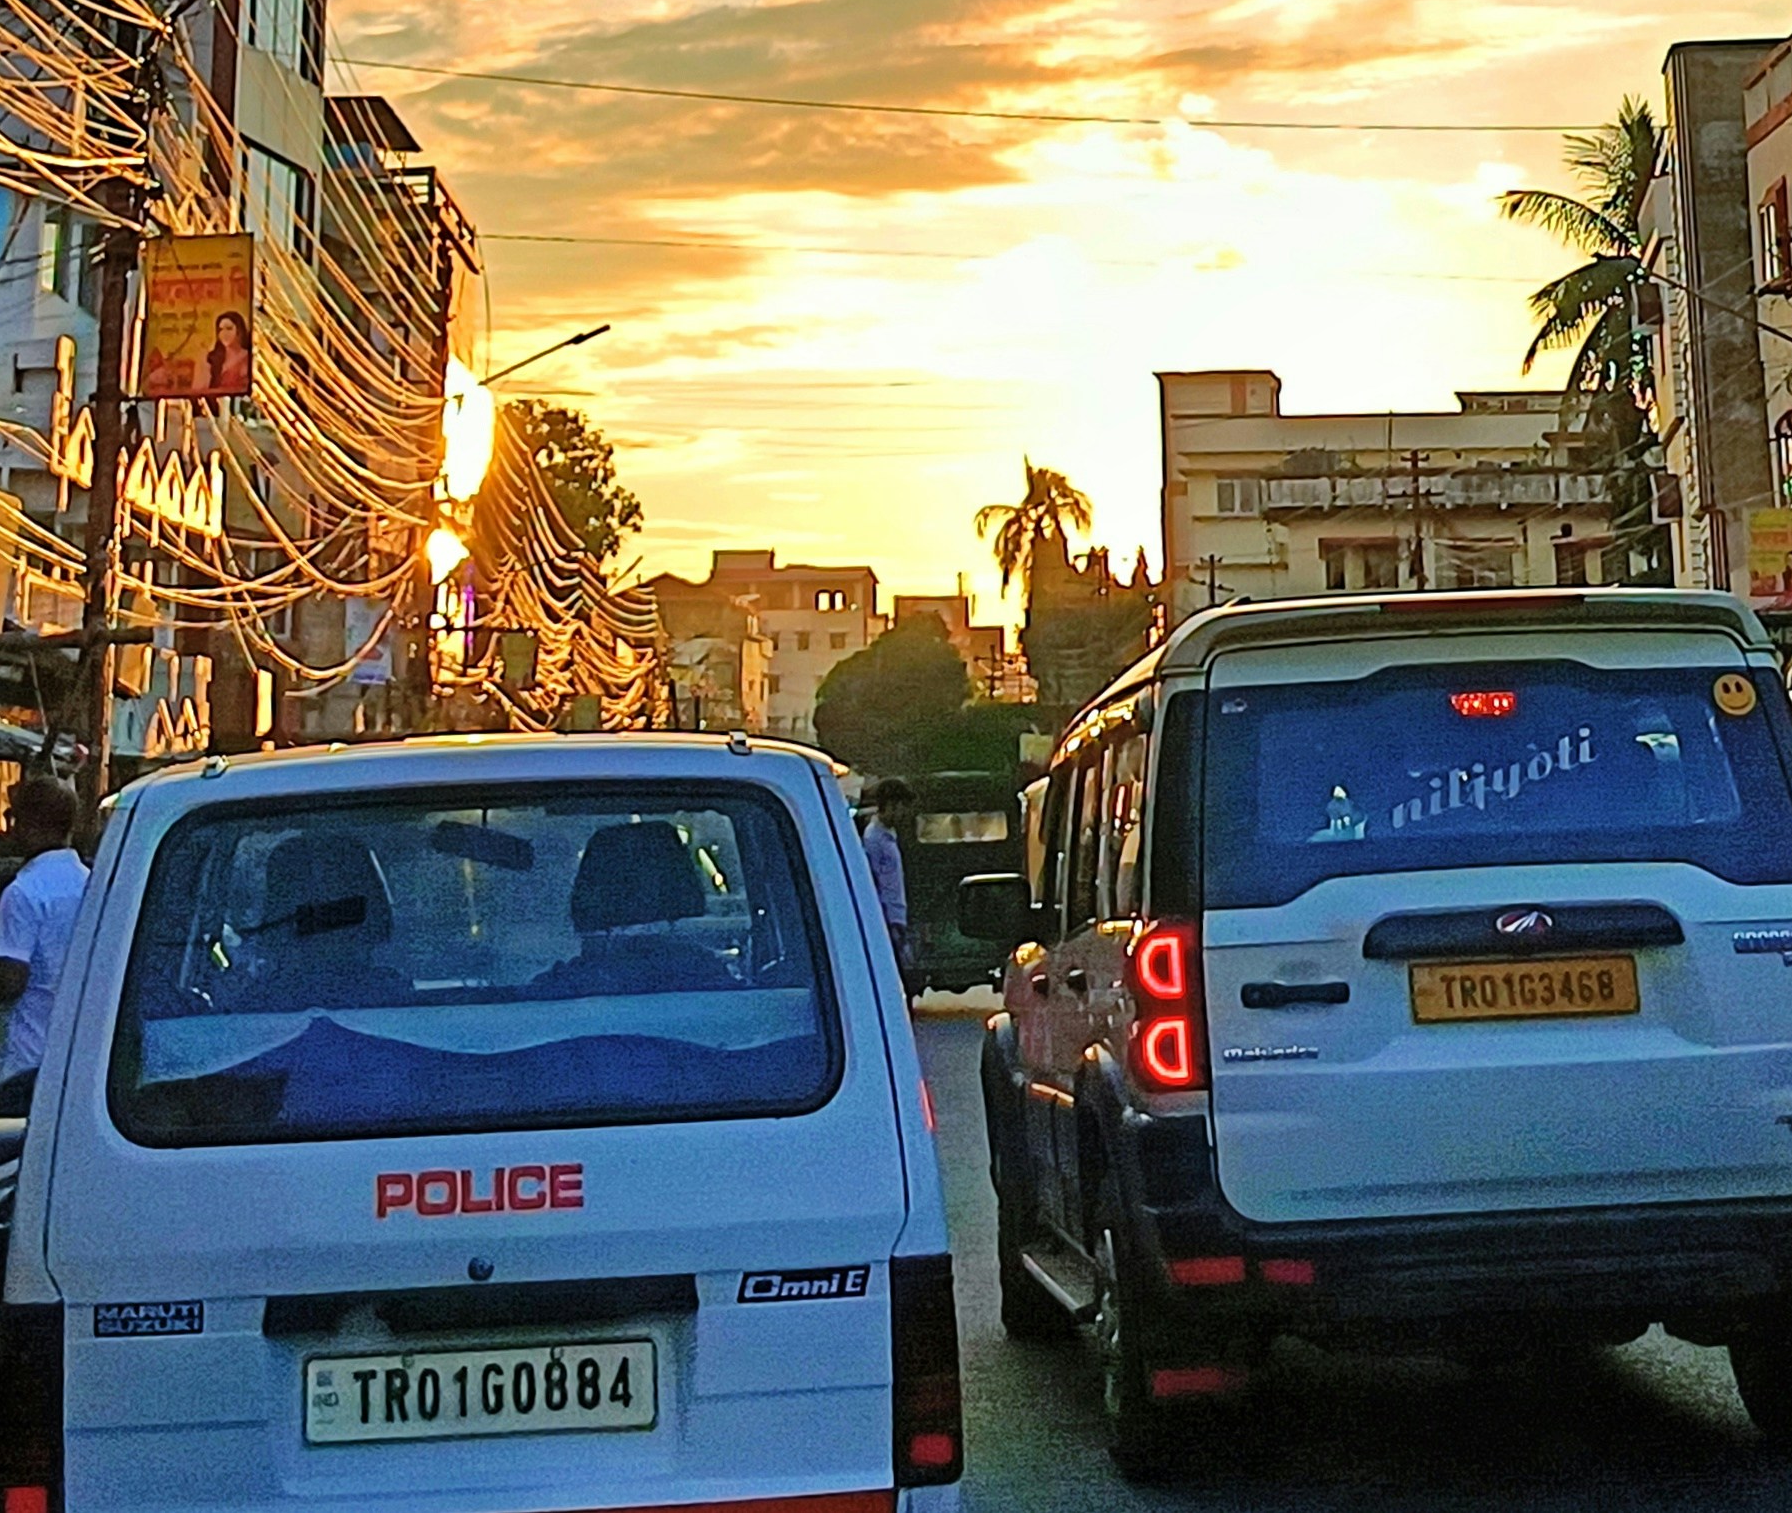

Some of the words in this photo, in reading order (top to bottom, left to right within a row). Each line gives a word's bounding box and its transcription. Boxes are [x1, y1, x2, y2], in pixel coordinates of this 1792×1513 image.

[375, 1163, 585, 1218] POLICE
[744, 1273, 840, 1299] Omni
[845, 1269, 866, 1292] E
[97, 1302, 200, 1320] MARUTI
[97, 1318, 200, 1334] SUZUKI
[352, 1356, 634, 1424] TR01G0884
